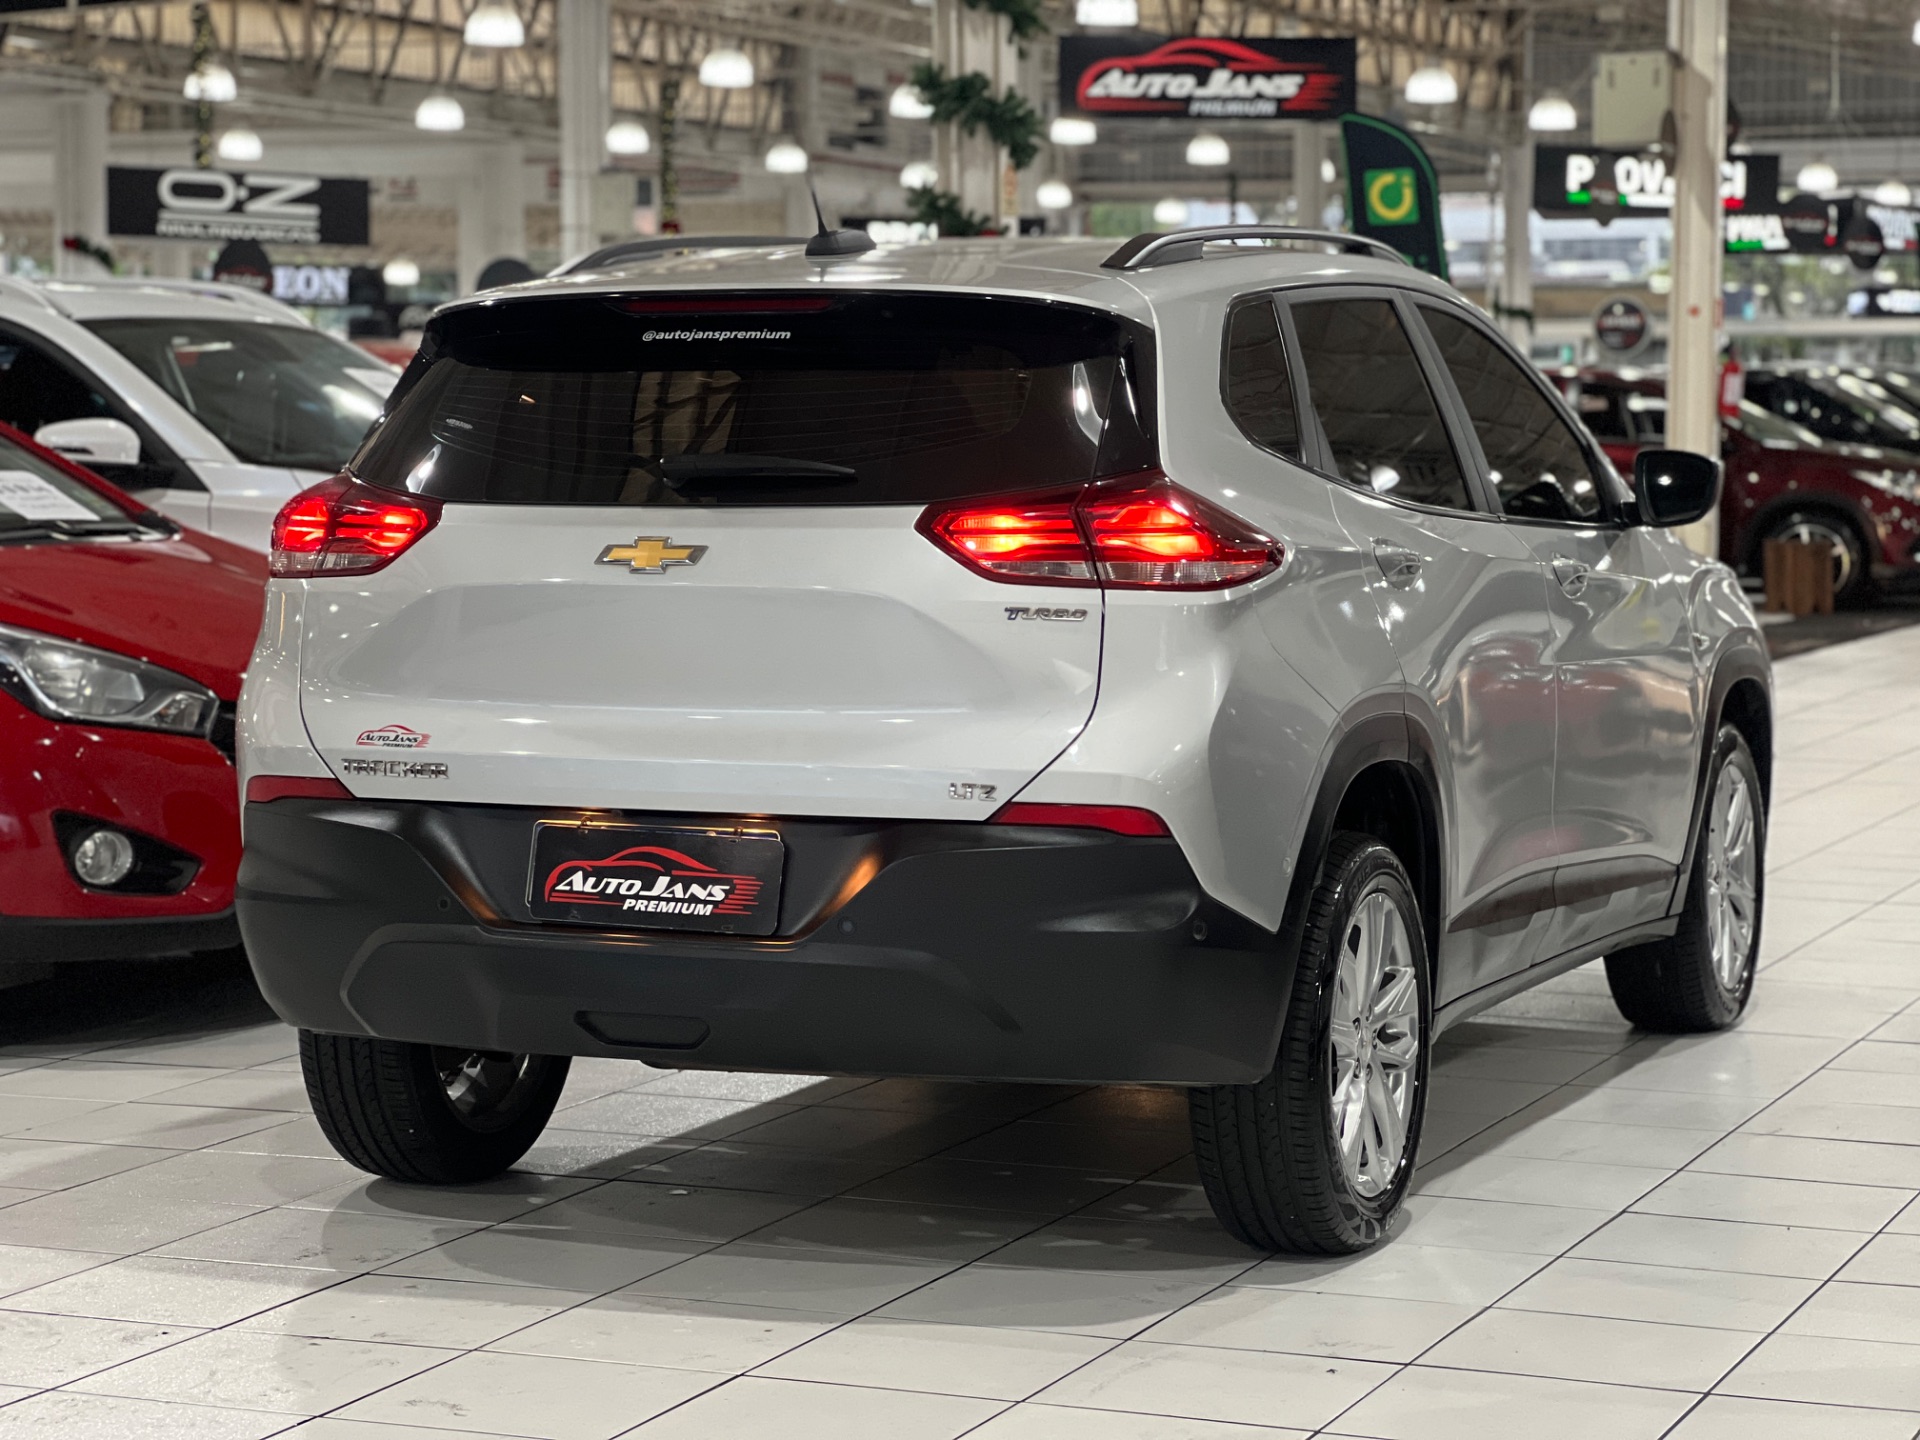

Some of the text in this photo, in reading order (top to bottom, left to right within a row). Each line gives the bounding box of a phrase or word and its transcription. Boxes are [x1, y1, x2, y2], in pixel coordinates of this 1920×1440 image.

[1189, 99, 1277, 117] PREMIUM
[642, 329, 791, 341] @autojanspremium
[1004, 606, 1088, 621] TURBO
[341, 758, 449, 779] TRACKER
[948, 782, 997, 802] LTZ
[623, 899, 713, 916] PREMIUM
